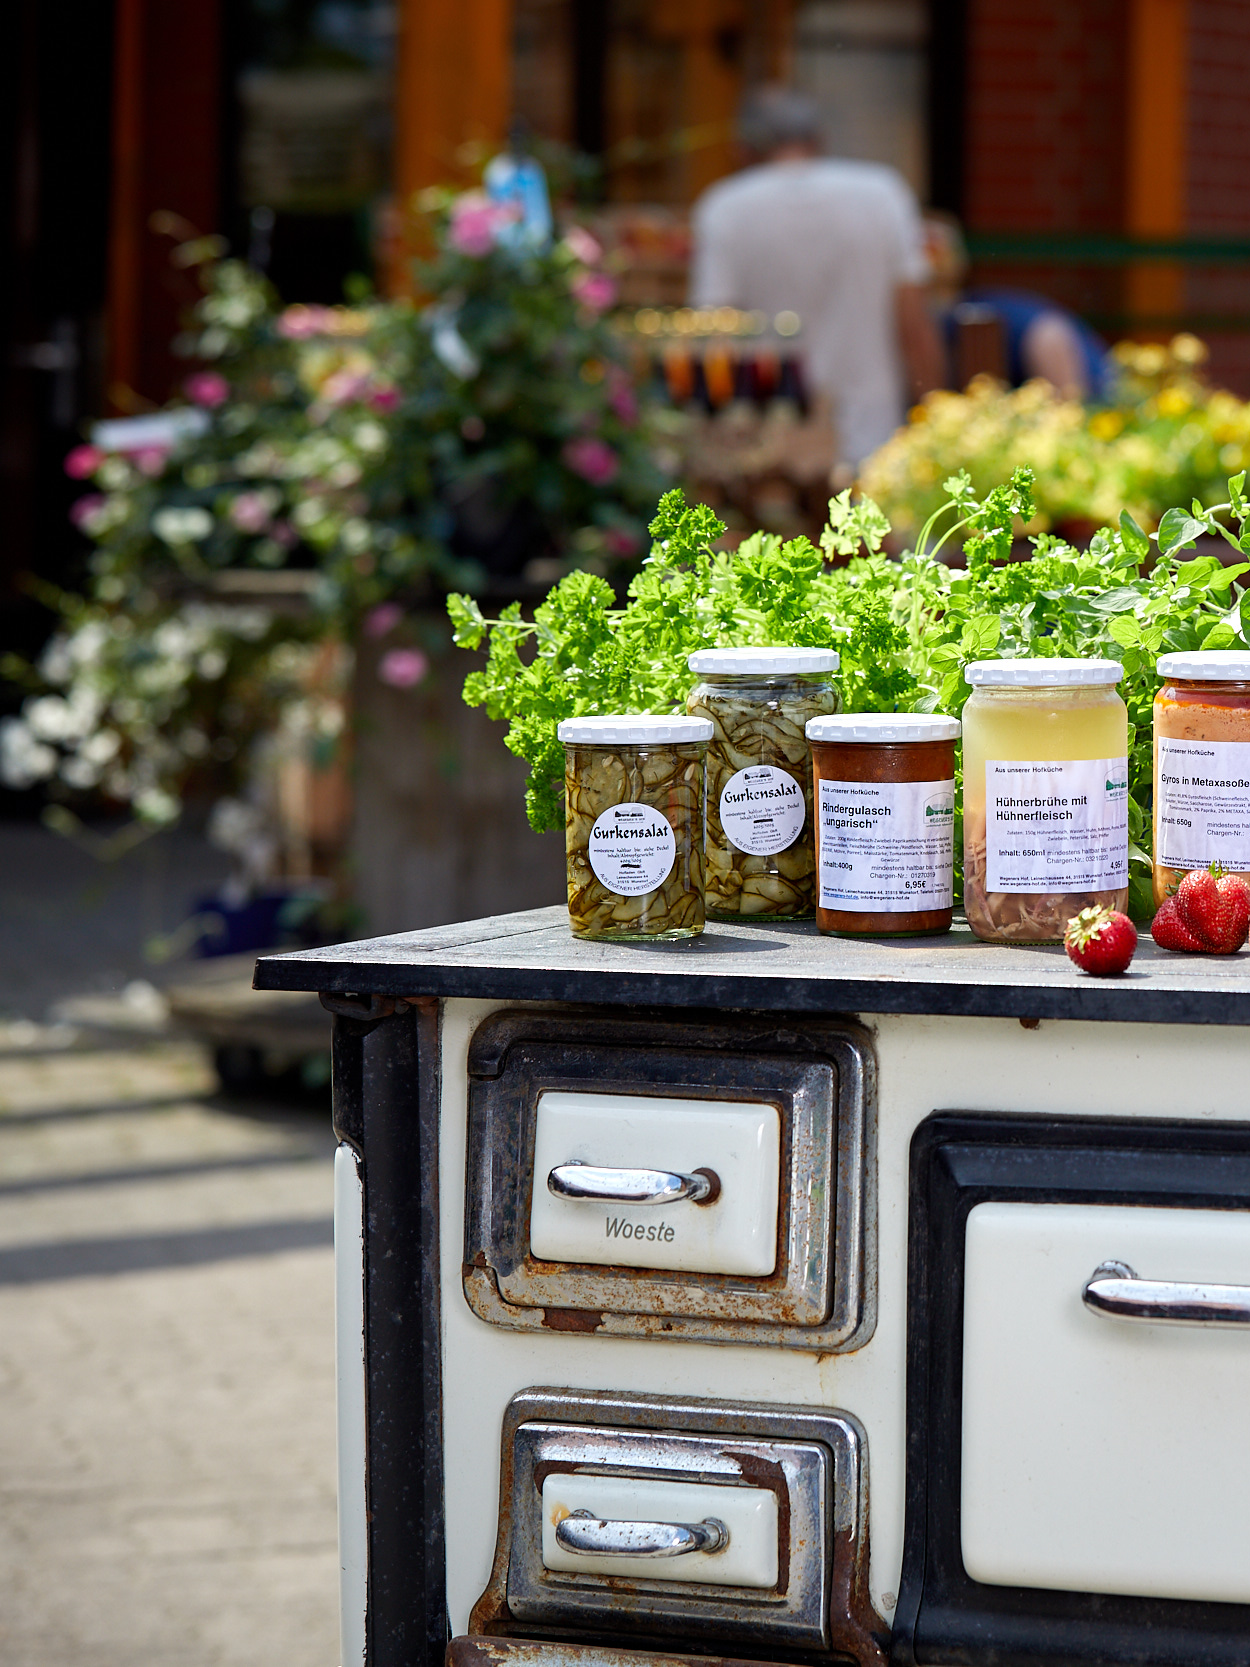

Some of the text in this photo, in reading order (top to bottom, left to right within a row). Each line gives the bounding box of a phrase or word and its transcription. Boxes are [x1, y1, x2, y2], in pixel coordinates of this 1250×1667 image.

[1162, 774, 1250, 788] Gyros in Metaxasoße
[724, 783, 797, 803] Gurkensalat
[850, 788, 880, 796] Hofküche
[996, 796, 1088, 807] Hühnerbrühe mit
[822, 802, 891, 816] Rindergulasch
[996, 810, 1073, 820] Hühnerfleisch
[1176, 818, 1192, 828] 650g
[594, 823, 668, 839] Gurkensalat
[1047, 848, 1080, 856] mindestens
[1046, 857, 1084, 865] Chargen-Nr.:
[634, 868, 666, 890] HERSTELLUNG
[905, 880, 926, 889] 6,95€
[606, 1216, 675, 1242] Woeste
